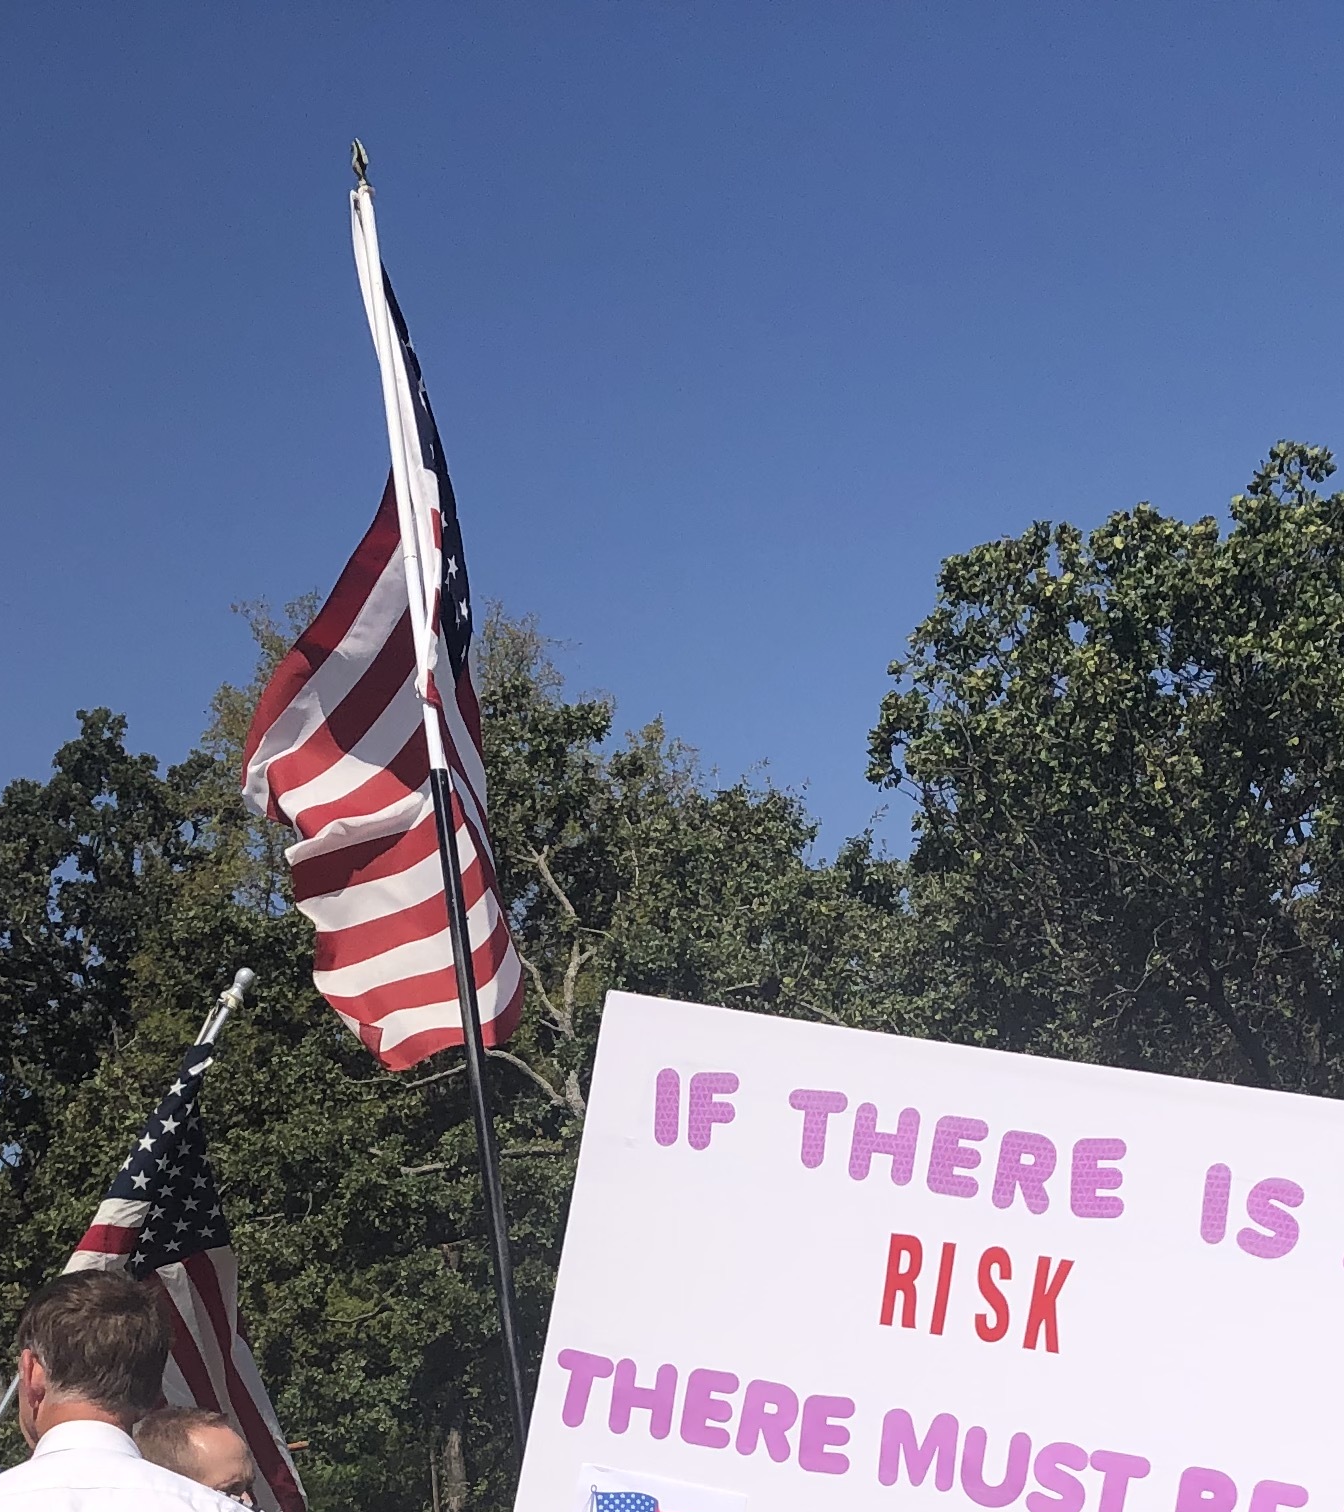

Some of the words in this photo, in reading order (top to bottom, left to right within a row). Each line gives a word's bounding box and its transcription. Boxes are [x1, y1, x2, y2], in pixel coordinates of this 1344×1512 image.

[654, 1067, 740, 1150] IF
[788, 1088, 1128, 1220] THERE
[1200, 1163, 1305, 1260] IS
[879, 1232, 1075, 1354] RISK
[556, 1347, 856, 1476] THERE
